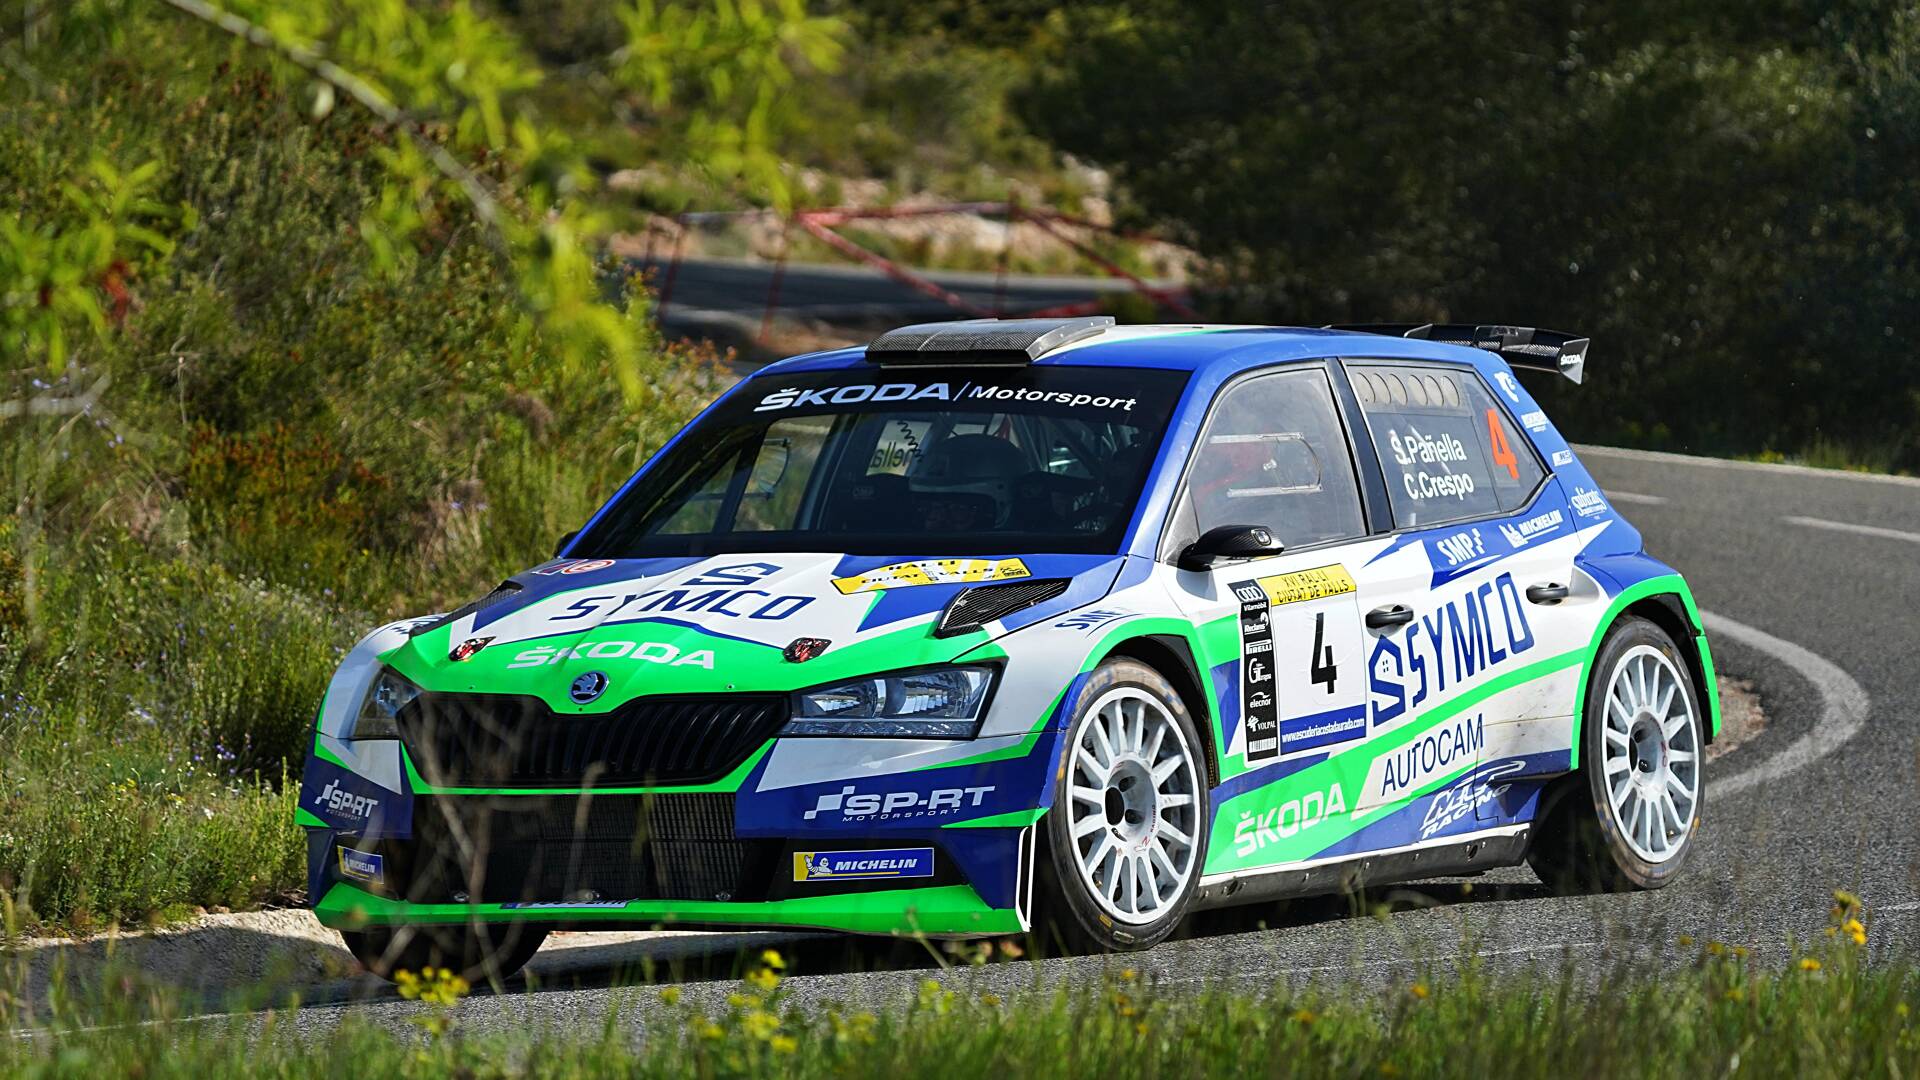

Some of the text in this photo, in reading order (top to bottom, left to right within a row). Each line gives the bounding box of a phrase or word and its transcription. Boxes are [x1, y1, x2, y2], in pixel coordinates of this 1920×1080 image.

[753, 383, 1137, 412] ŠKODA Motorsport
[1390, 433, 1467, 465] S.Pañella
[1486, 408, 1520, 480] 4
[1403, 471, 1475, 500] C.Crespo
[1518, 510, 1563, 535] MICHELIN
[1436, 532, 1475, 566] SMP
[548, 590, 817, 621] SYMCO
[1276, 579, 1349, 603] CIUTAT DE VALLS
[507, 641, 714, 669] ŠKODA
[1246, 639, 1272, 655] PIRELLI
[1311, 612, 1337, 694] 4
[1406, 572, 1535, 708] SYMCO
[1249, 699, 1271, 708] elecnor
[1381, 713, 1484, 796] AUTOCAM
[842, 808, 960, 822] MOTORSPORT
[1234, 782, 1347, 858] ŠKODA
[1422, 784, 1512, 840] RACING
[835, 858, 918, 871] MICHELIN
